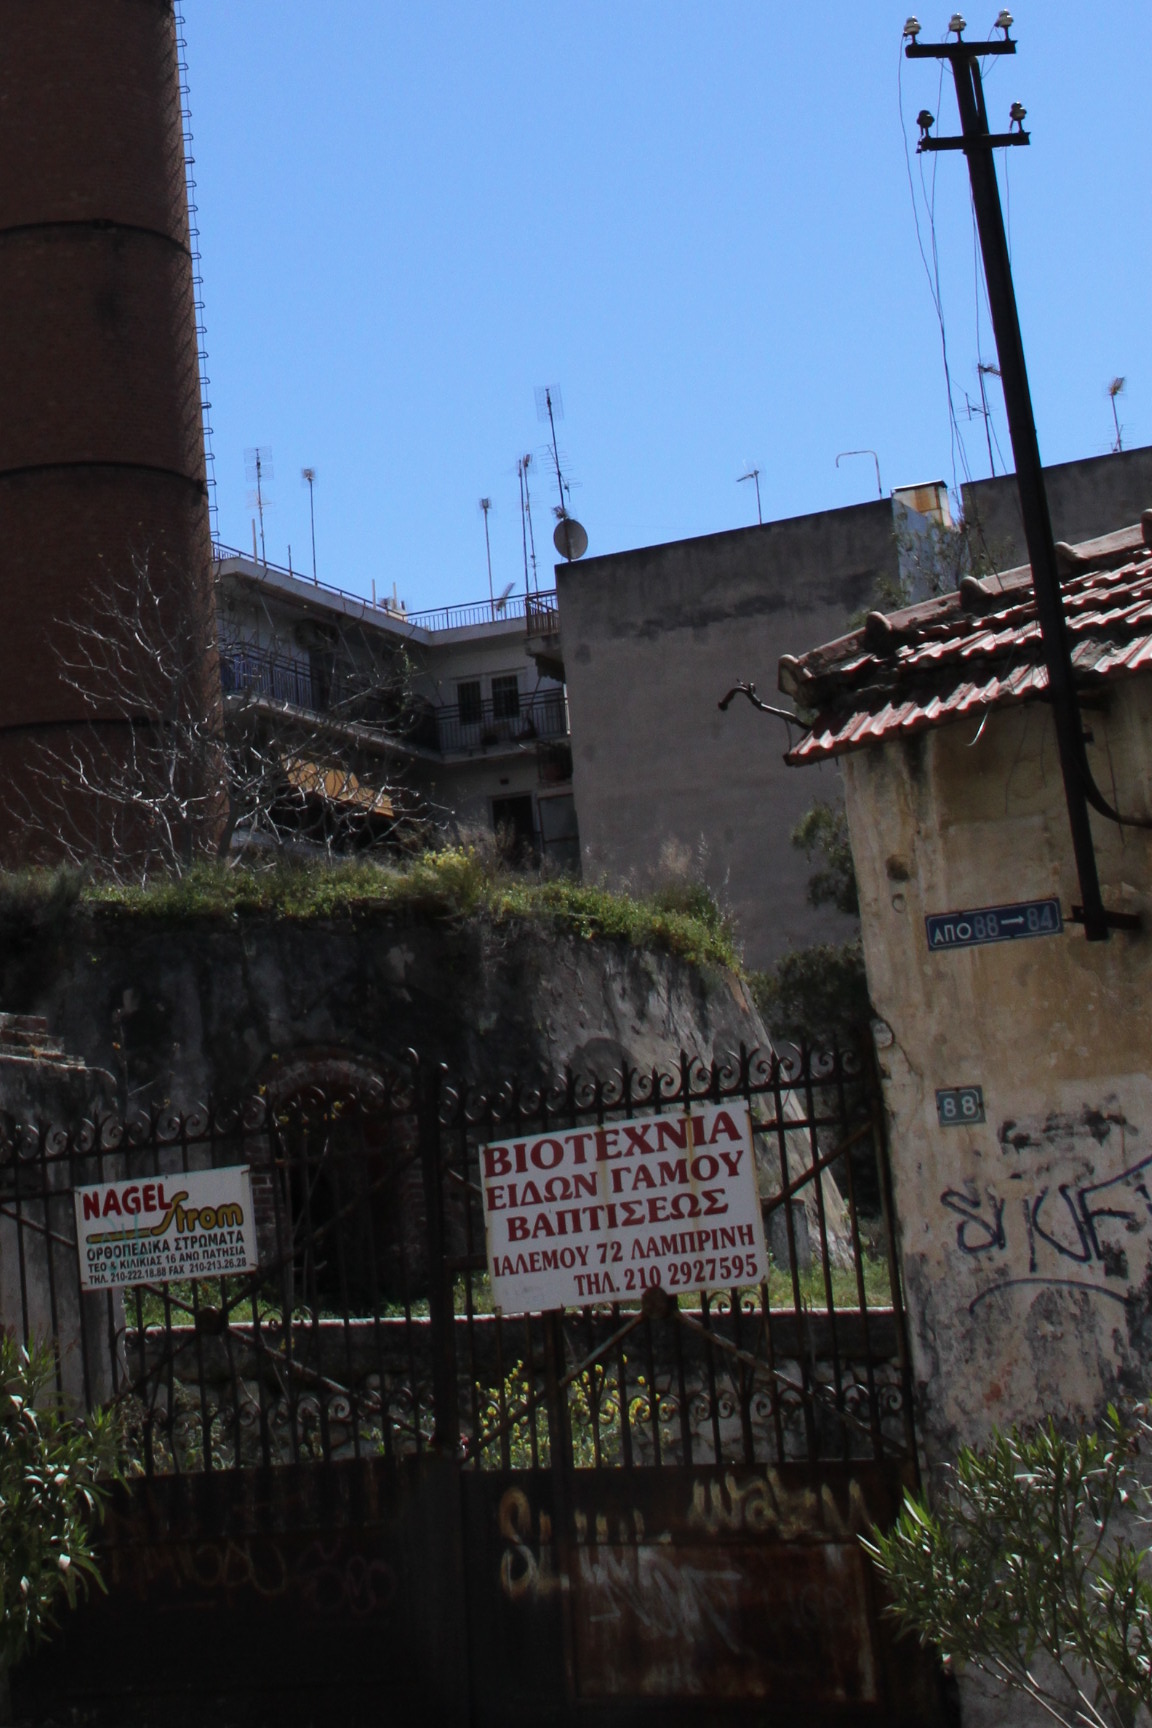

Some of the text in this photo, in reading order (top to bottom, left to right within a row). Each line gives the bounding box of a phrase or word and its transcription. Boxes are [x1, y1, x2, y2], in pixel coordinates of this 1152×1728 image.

[934, 905, 1054, 944] ΑΠΟ 88 84
[943, 1095, 977, 1117] 88
[483, 1111, 743, 1178] ΒΙΟΤΕΧΝΙΑ
[83, 1183, 172, 1220] NAGEL
[486, 1150, 744, 1211] ΕΙΔΩΝ ΓΑΜΟΥ
[150, 1190, 244, 1236] Strom
[506, 1188, 729, 1242] ΒΑΠΤΙΣΕΩΣ
[87, 1230, 245, 1261] ΟΡΘΟΠΕΔΙΚΑ ΣΤΡΩΜΑΤΑ
[88, 1262, 107, 1273] ΤΕΟ
[119, 1255, 162, 1269] ΚΙΛΙΚΙΑΣ
[165, 1253, 176, 1264] 16
[179, 1250, 199, 1262] ΑΝΩ
[202, 1245, 246, 1260] ΠΑΤΗΣΙΑ
[493, 1224, 755, 1278] ΙΑΛΕΜΟΥ 72 ΛΑΜΠΡΙΝΗ
[89, 1274, 108, 1285] ΤΗΛ.
[168, 1265, 185, 1276] FAX
[574, 1253, 758, 1298] ΤΗΛ. 210 2927595
